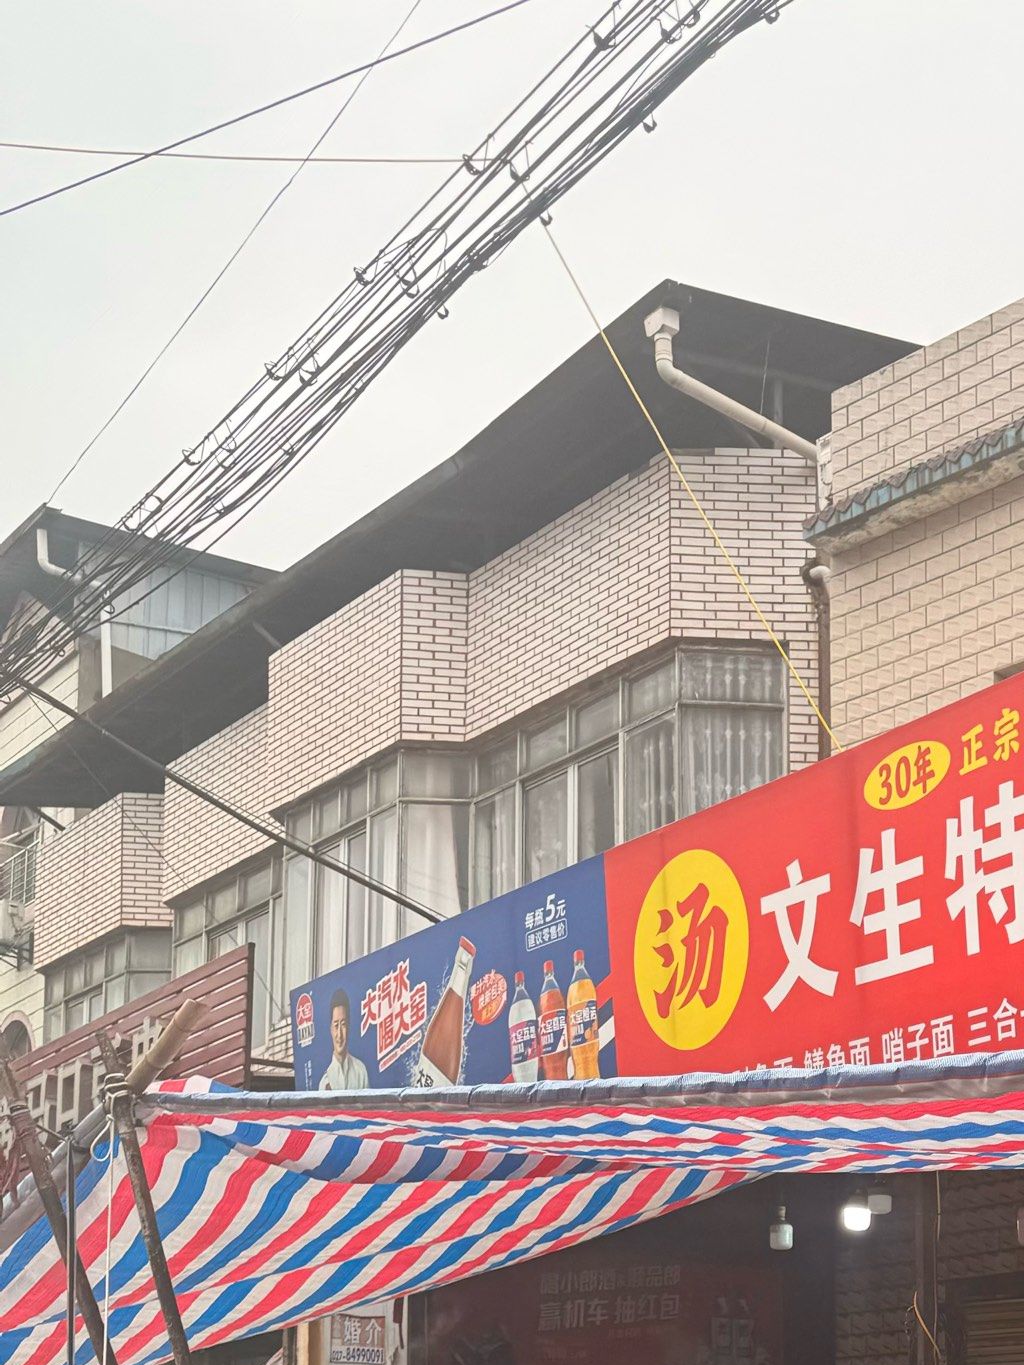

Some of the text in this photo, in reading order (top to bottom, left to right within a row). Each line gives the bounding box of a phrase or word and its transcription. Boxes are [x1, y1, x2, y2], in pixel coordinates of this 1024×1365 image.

[877, 744, 936, 806] 30年
[652, 882, 730, 1020] 汤
[881, 1014, 954, 1063] 哨子面
[343, 1316, 382, 1345] 婚介
